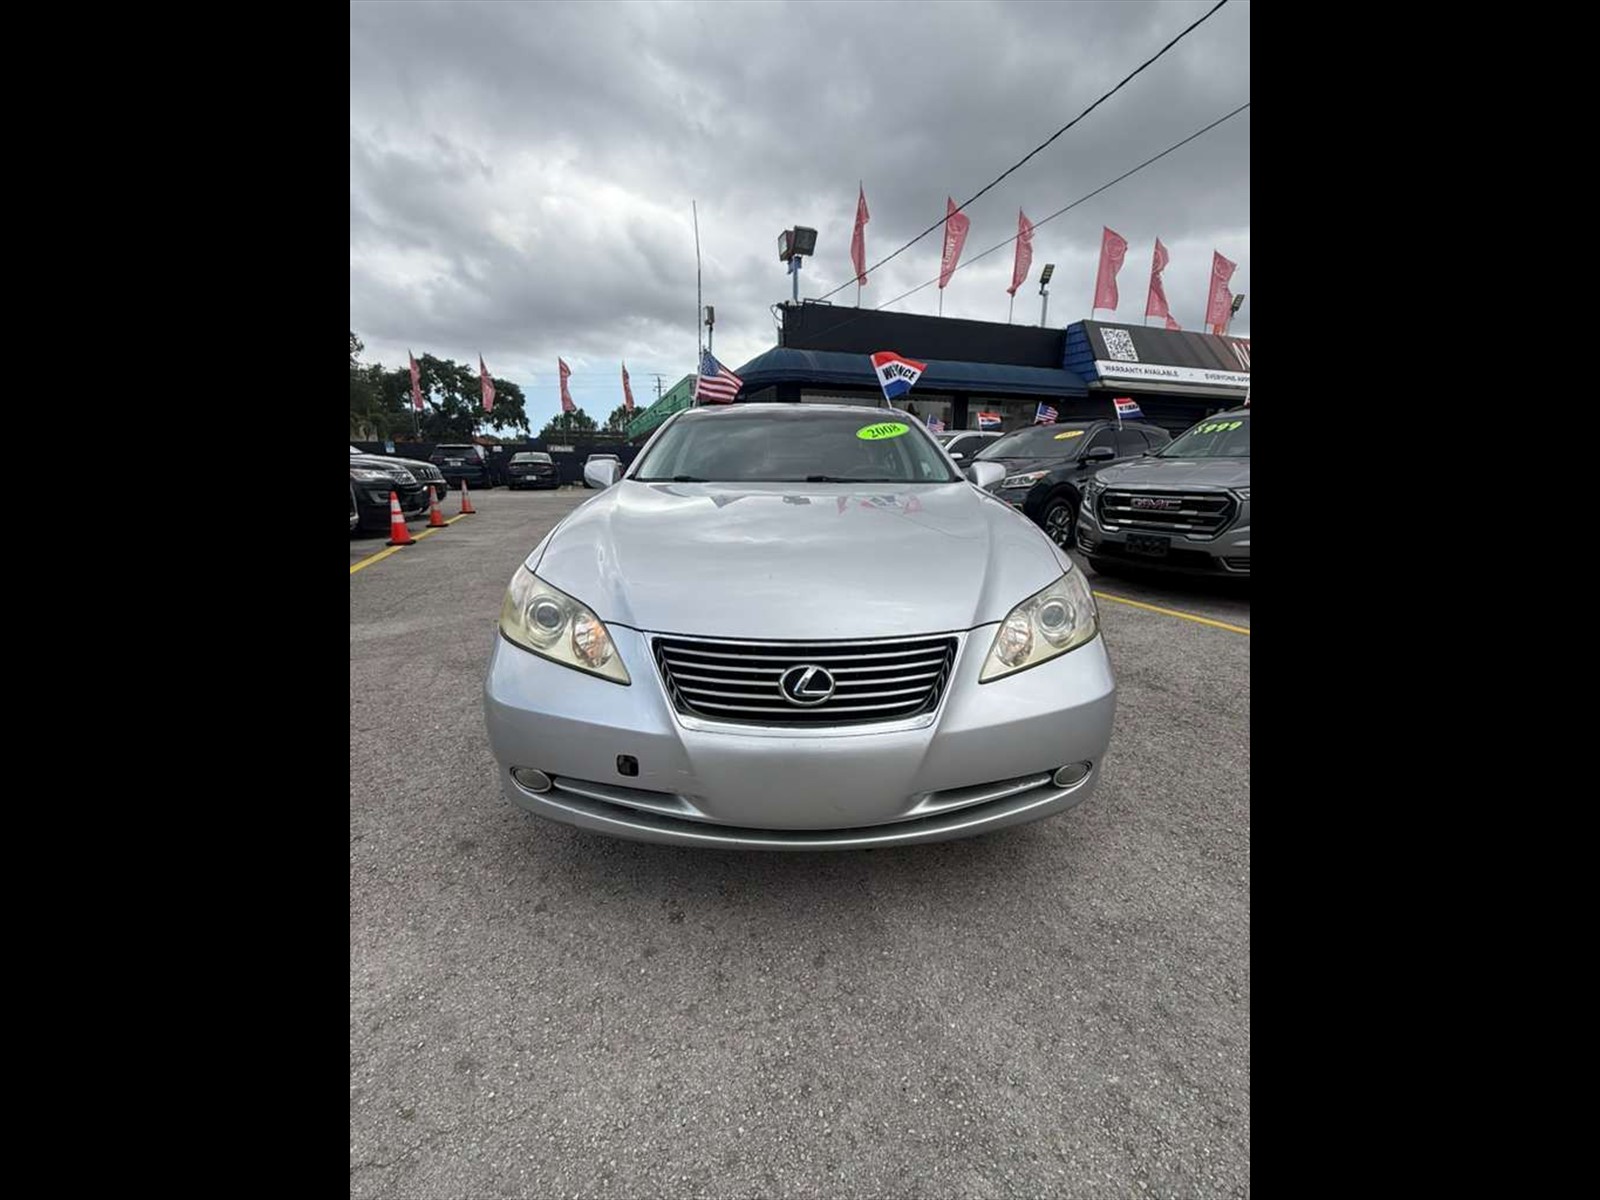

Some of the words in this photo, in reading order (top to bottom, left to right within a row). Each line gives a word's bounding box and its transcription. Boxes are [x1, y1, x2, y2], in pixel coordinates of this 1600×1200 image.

[1104, 365, 1142, 375] WARRANTY
[1143, 368, 1180, 378] AVAILABLE
[866, 425, 900, 437] 2008
[1131, 498, 1181, 510] GMC
